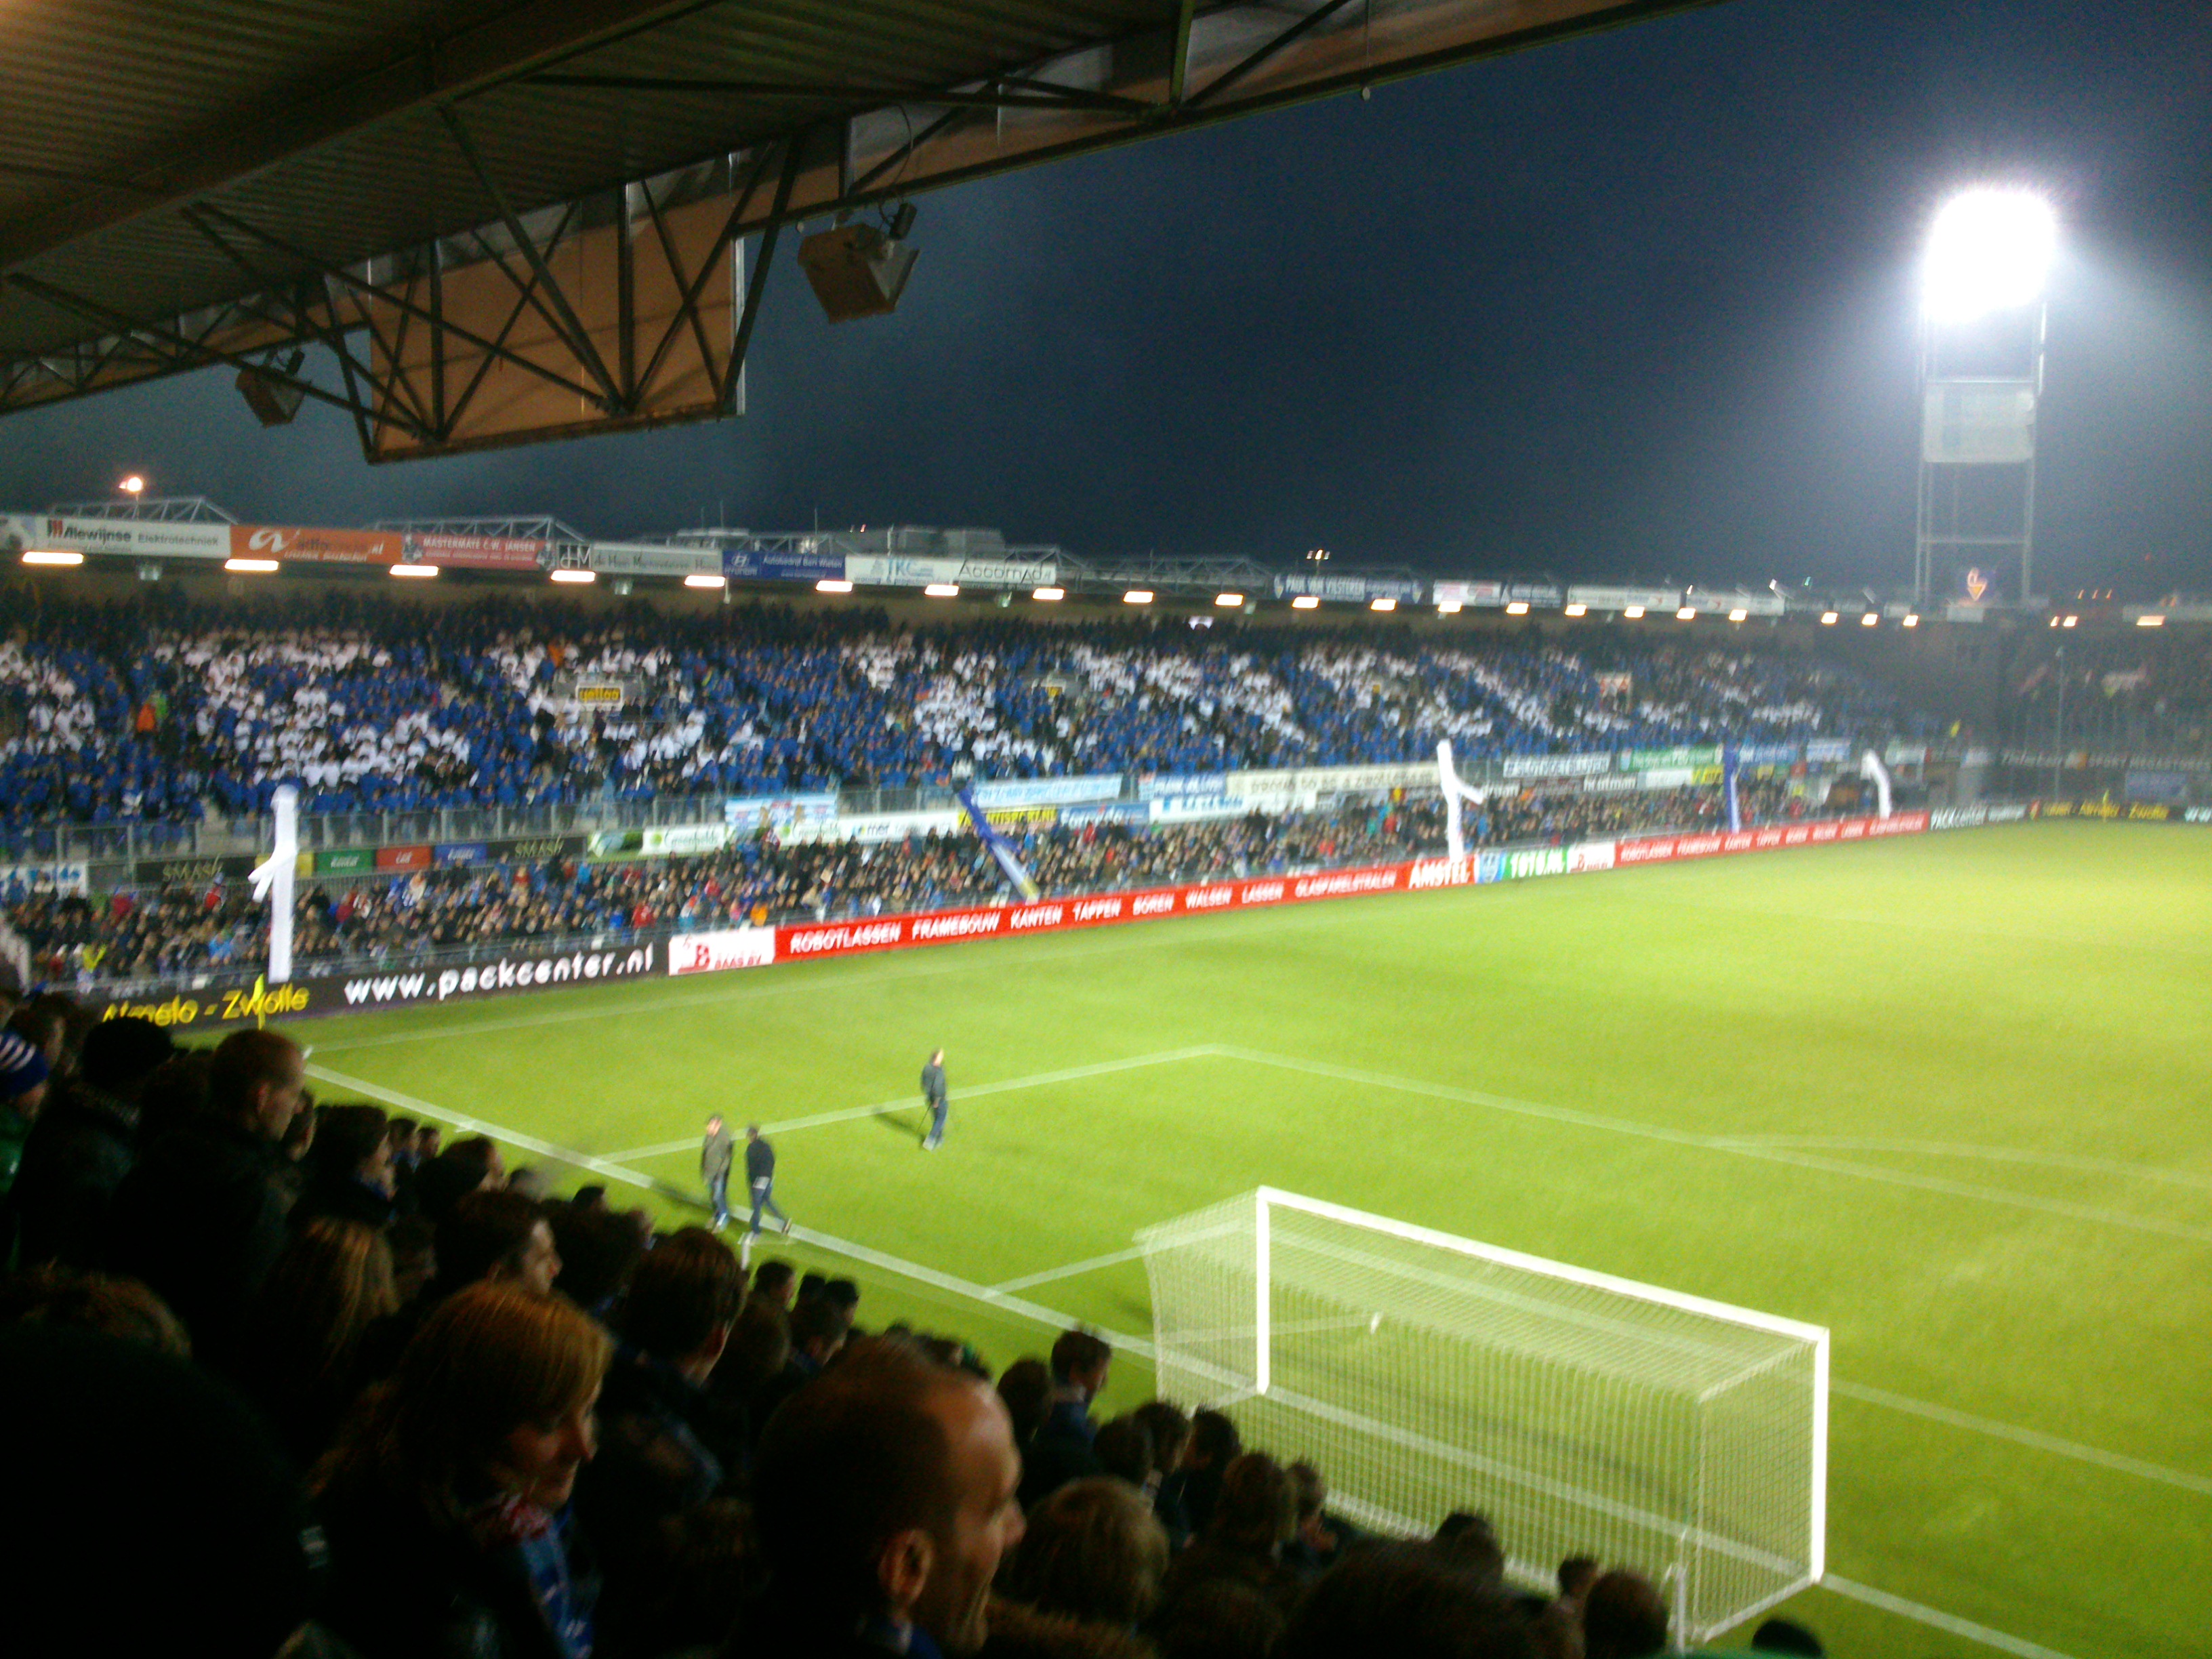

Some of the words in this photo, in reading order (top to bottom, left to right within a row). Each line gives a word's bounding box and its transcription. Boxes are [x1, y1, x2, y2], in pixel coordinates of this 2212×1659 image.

[64, 526, 131, 544] Alewijnse
[138, 531, 219, 546] Elektrotechniek
[424, 536, 480, 550] MASTERMATE
[505, 540, 536, 552] JANSEN
[664, 826, 718, 852] Greenfields
[1620, 840, 1674, 863] ROBOTLASSEN
[1408, 854, 1470, 889] AMSTEL
[1511, 849, 1565, 878] TOTO.NL
[790, 922, 902, 954] ROBOTLASSEN
[912, 911, 1001, 941] FRAMEBOUW
[1010, 904, 1063, 929] KANTEN
[1073, 898, 1122, 922] TAPPEN
[1132, 891, 1175, 916] BOREN
[1185, 886, 1233, 909] WALSEN
[1242, 882, 1284, 904] LASSEN
[344, 941, 653, 1005] www.packcenter.nl
